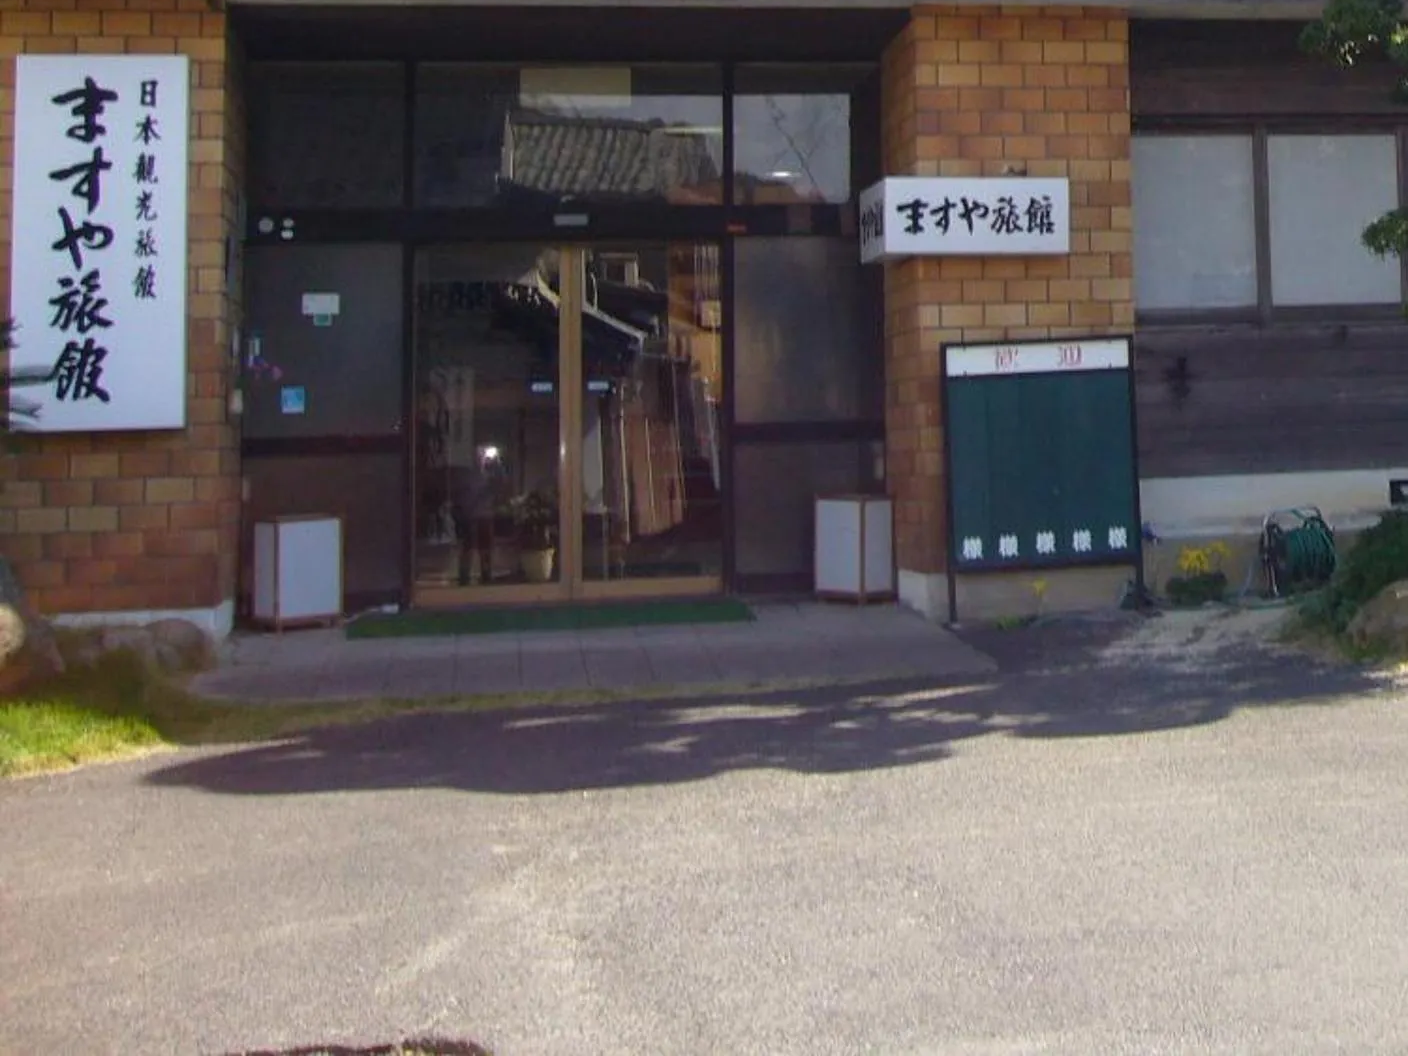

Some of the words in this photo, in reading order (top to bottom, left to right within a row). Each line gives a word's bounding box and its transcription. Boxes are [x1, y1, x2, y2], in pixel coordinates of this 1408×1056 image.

[896, 195, 1055, 235] ますや旅館
